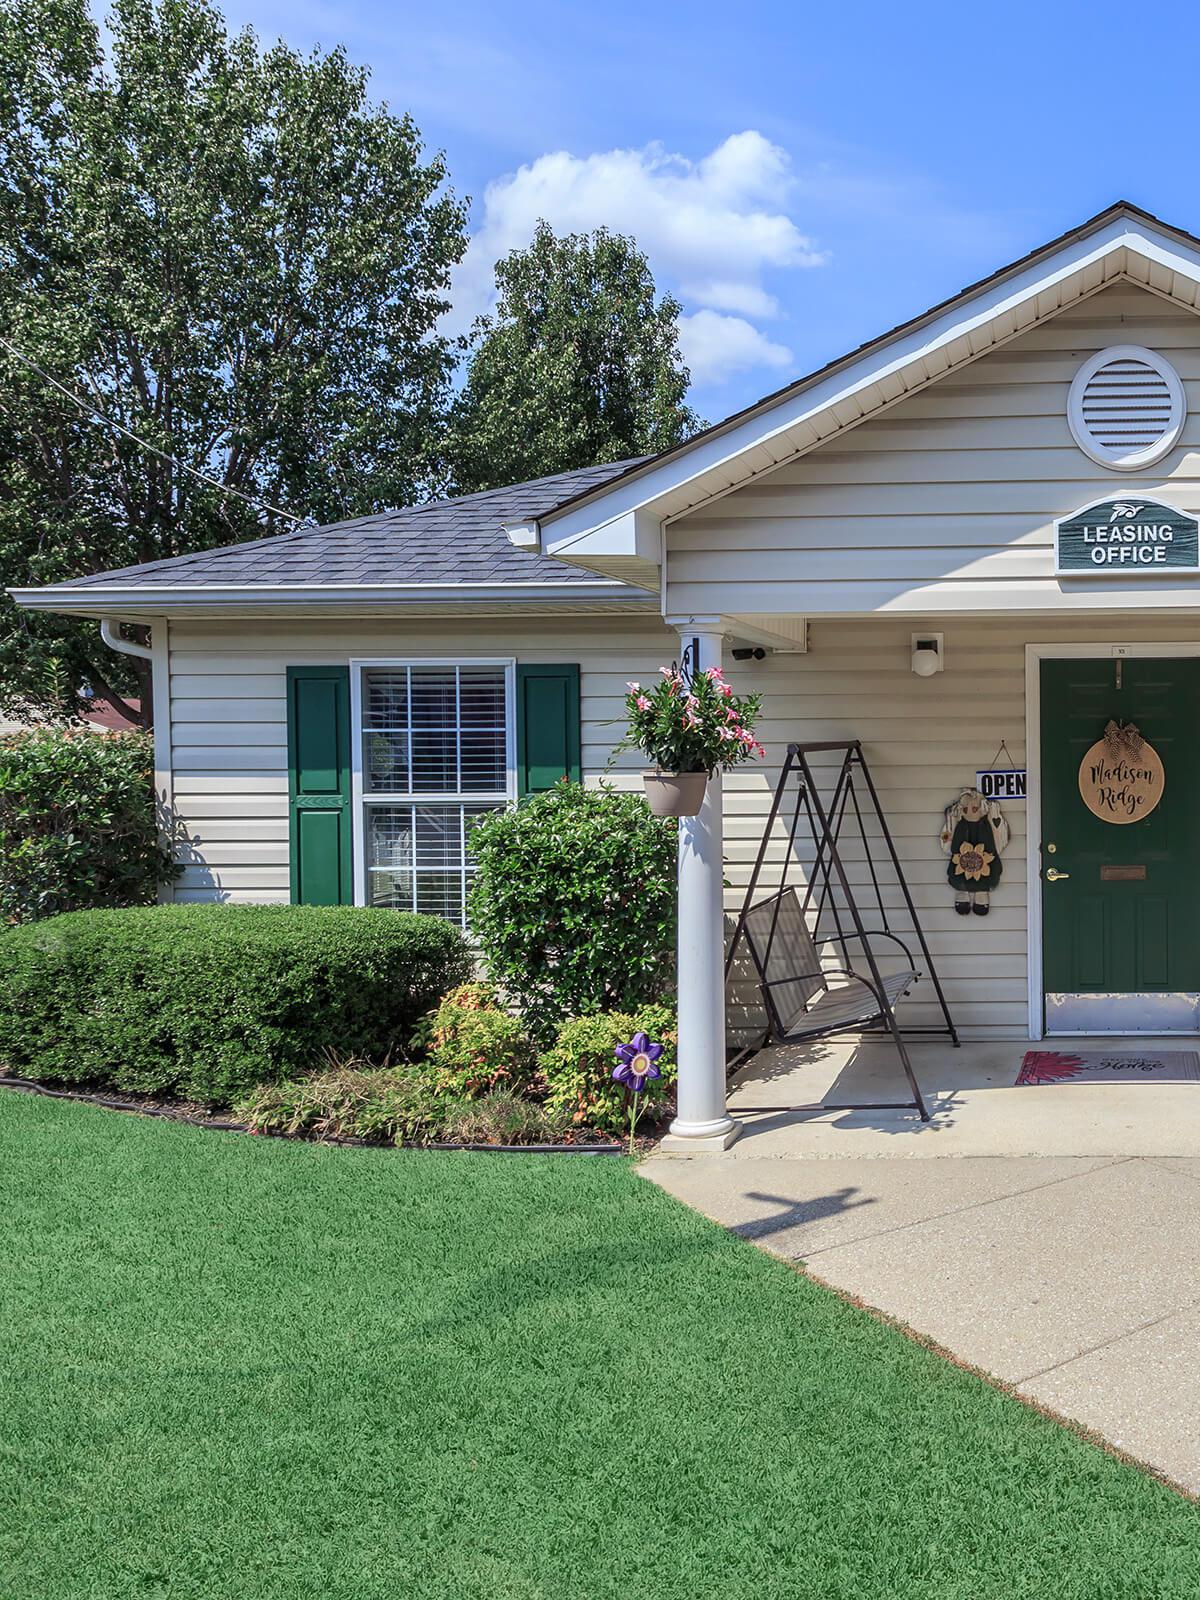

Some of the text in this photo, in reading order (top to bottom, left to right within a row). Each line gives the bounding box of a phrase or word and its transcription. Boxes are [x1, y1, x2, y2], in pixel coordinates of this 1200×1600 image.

[1083, 525, 1173, 543] LEASING
[1091, 546, 1167, 564] OFFICE
[1090, 758, 1154, 784] Madison
[981, 773, 1027, 796] OPEN
[1097, 785, 1145, 815] Ridge
